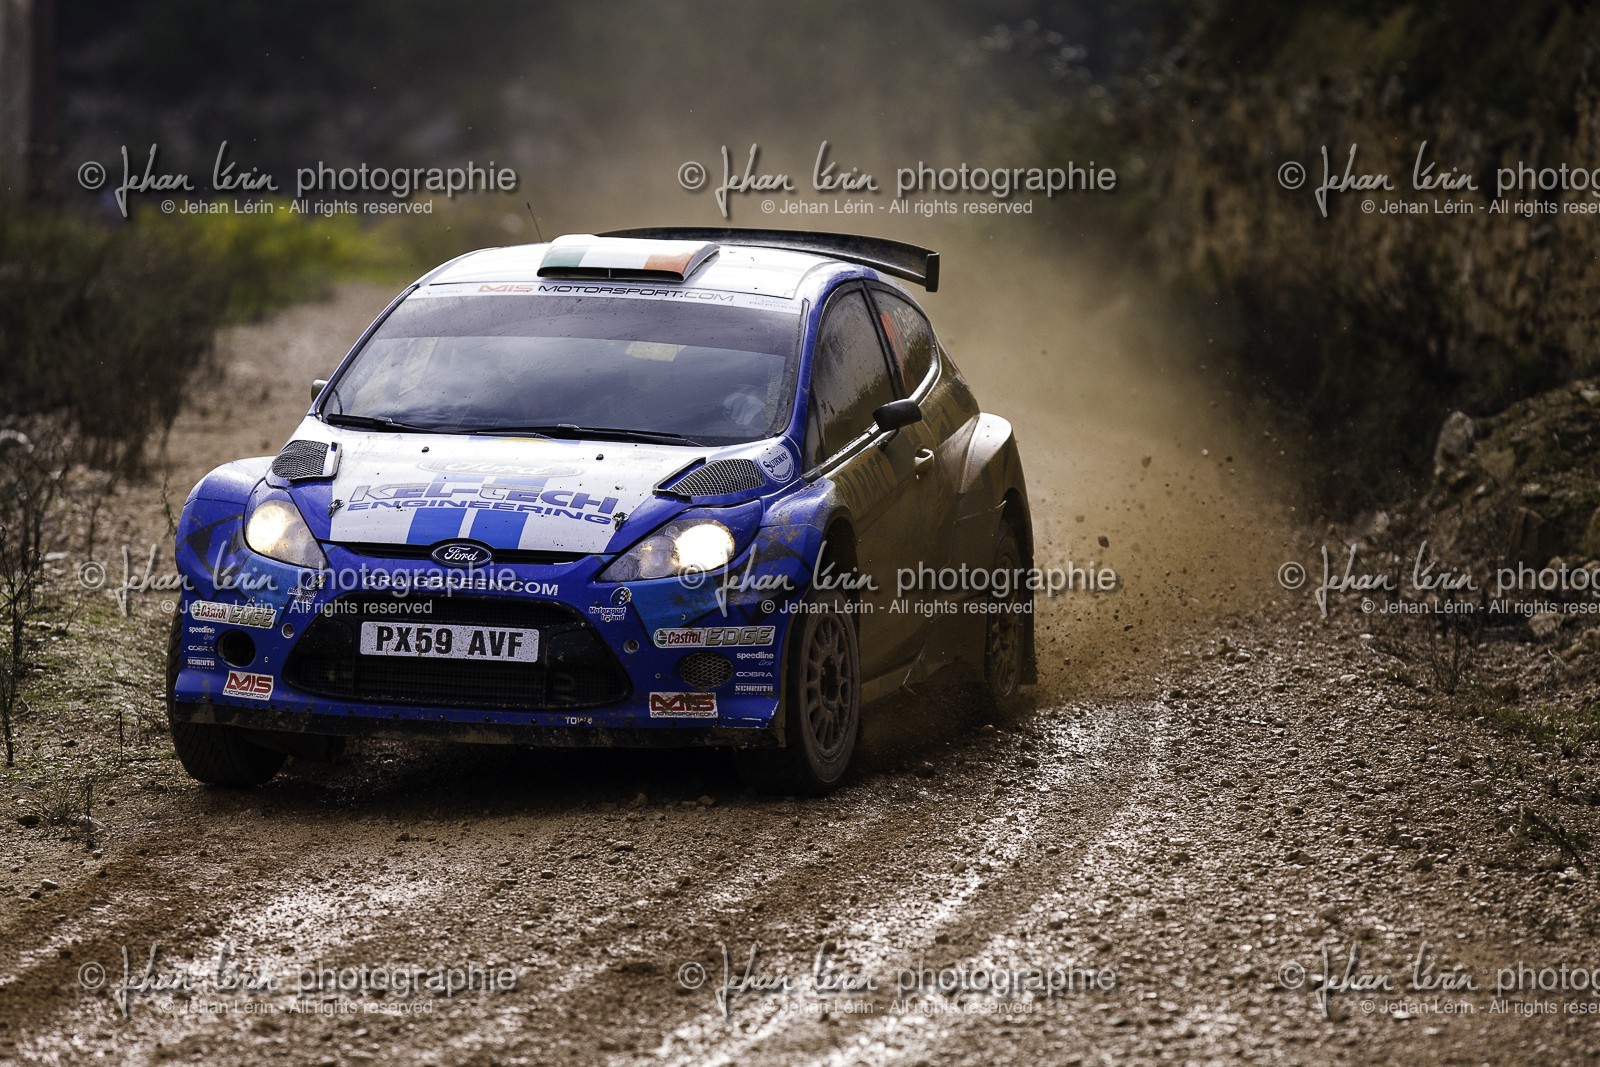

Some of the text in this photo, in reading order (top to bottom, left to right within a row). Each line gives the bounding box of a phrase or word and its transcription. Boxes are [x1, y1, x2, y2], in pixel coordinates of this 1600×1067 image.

[477, 284, 535, 293] MIS
[538, 285, 734, 301] MOTORSPORT.COM
[347, 499, 613, 525] ENGINEERING
[444, 546, 479, 561] Ford
[363, 575, 559, 596] CRAIGBREEN.COM
[200, 604, 276, 627] Castrol EDGE
[589, 606, 627, 615] Motorsport
[376, 625, 524, 658] PX59 AVF
[667, 626, 774, 646] Castrol EDGE
[736, 651, 774, 660] speedline
[226, 672, 272, 693] MIS
